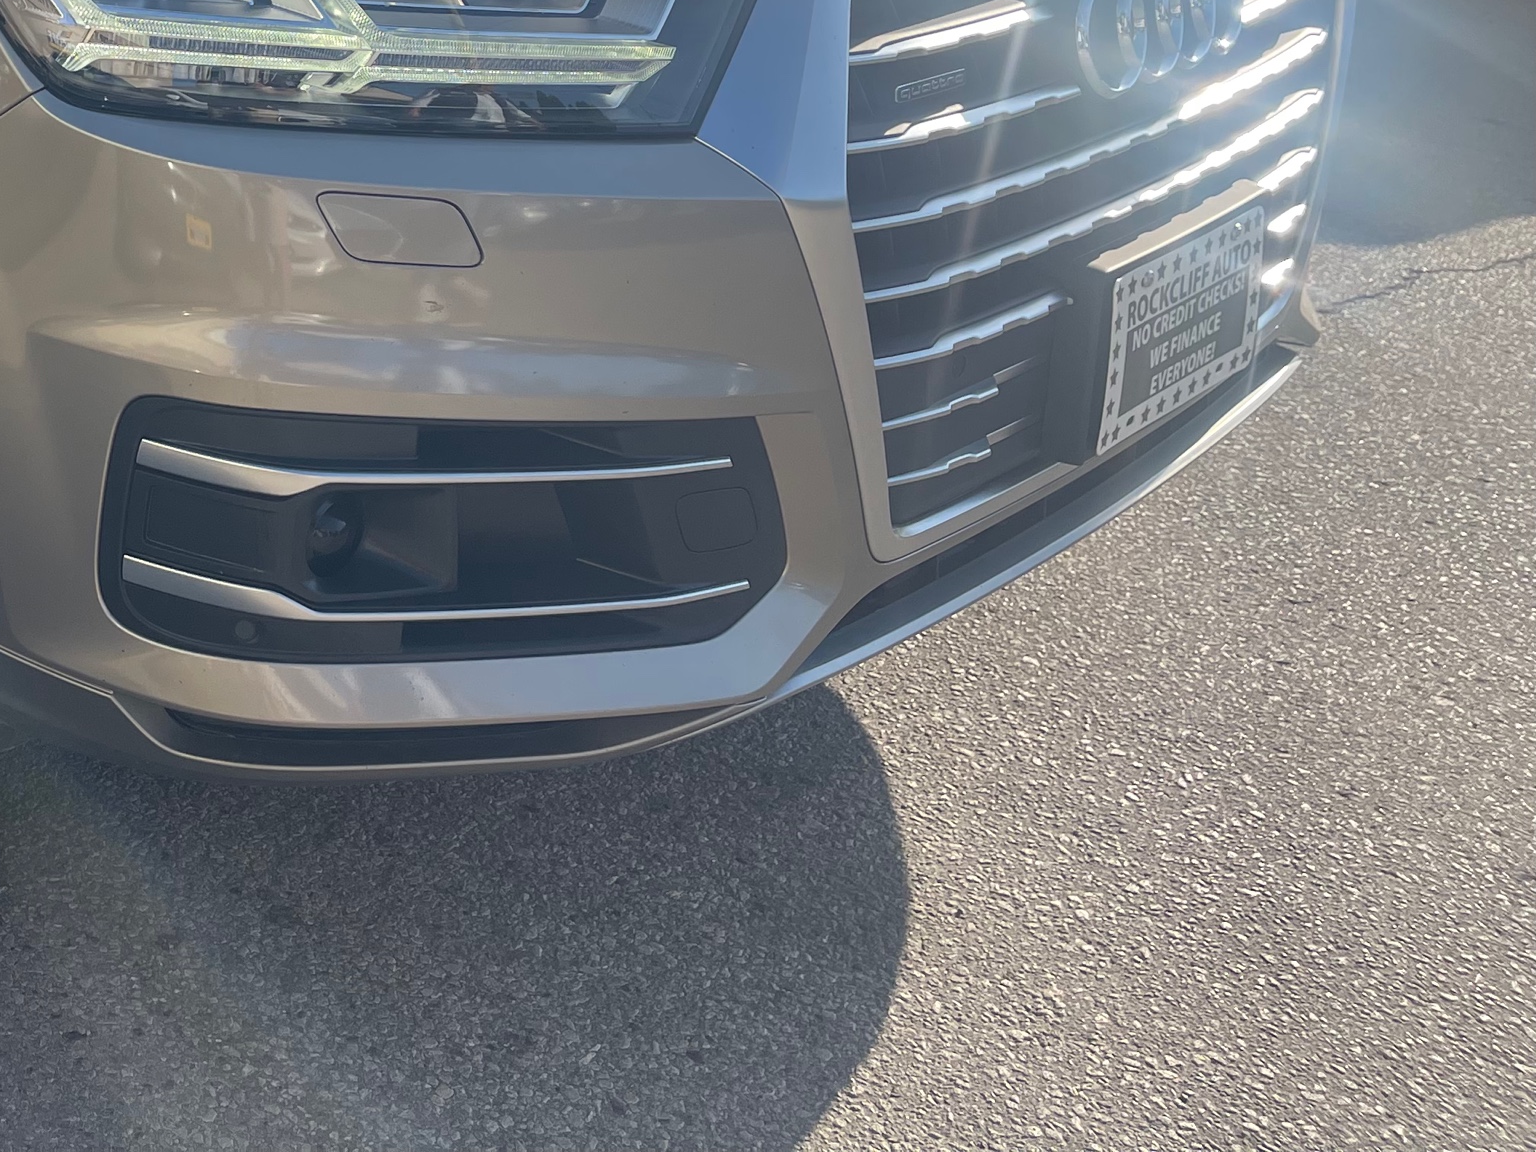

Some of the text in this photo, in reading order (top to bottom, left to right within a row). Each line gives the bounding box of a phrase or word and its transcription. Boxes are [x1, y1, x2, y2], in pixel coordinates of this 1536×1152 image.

[900, 73, 964, 100] quattro
[1127, 239, 1252, 330] ROCKCLIFF AUTO
[1132, 270, 1247, 352] NO CREDIT CHECKS!
[1149, 311, 1222, 369] WE FINANCE
[1149, 340, 1217, 396] EVERYONE!
